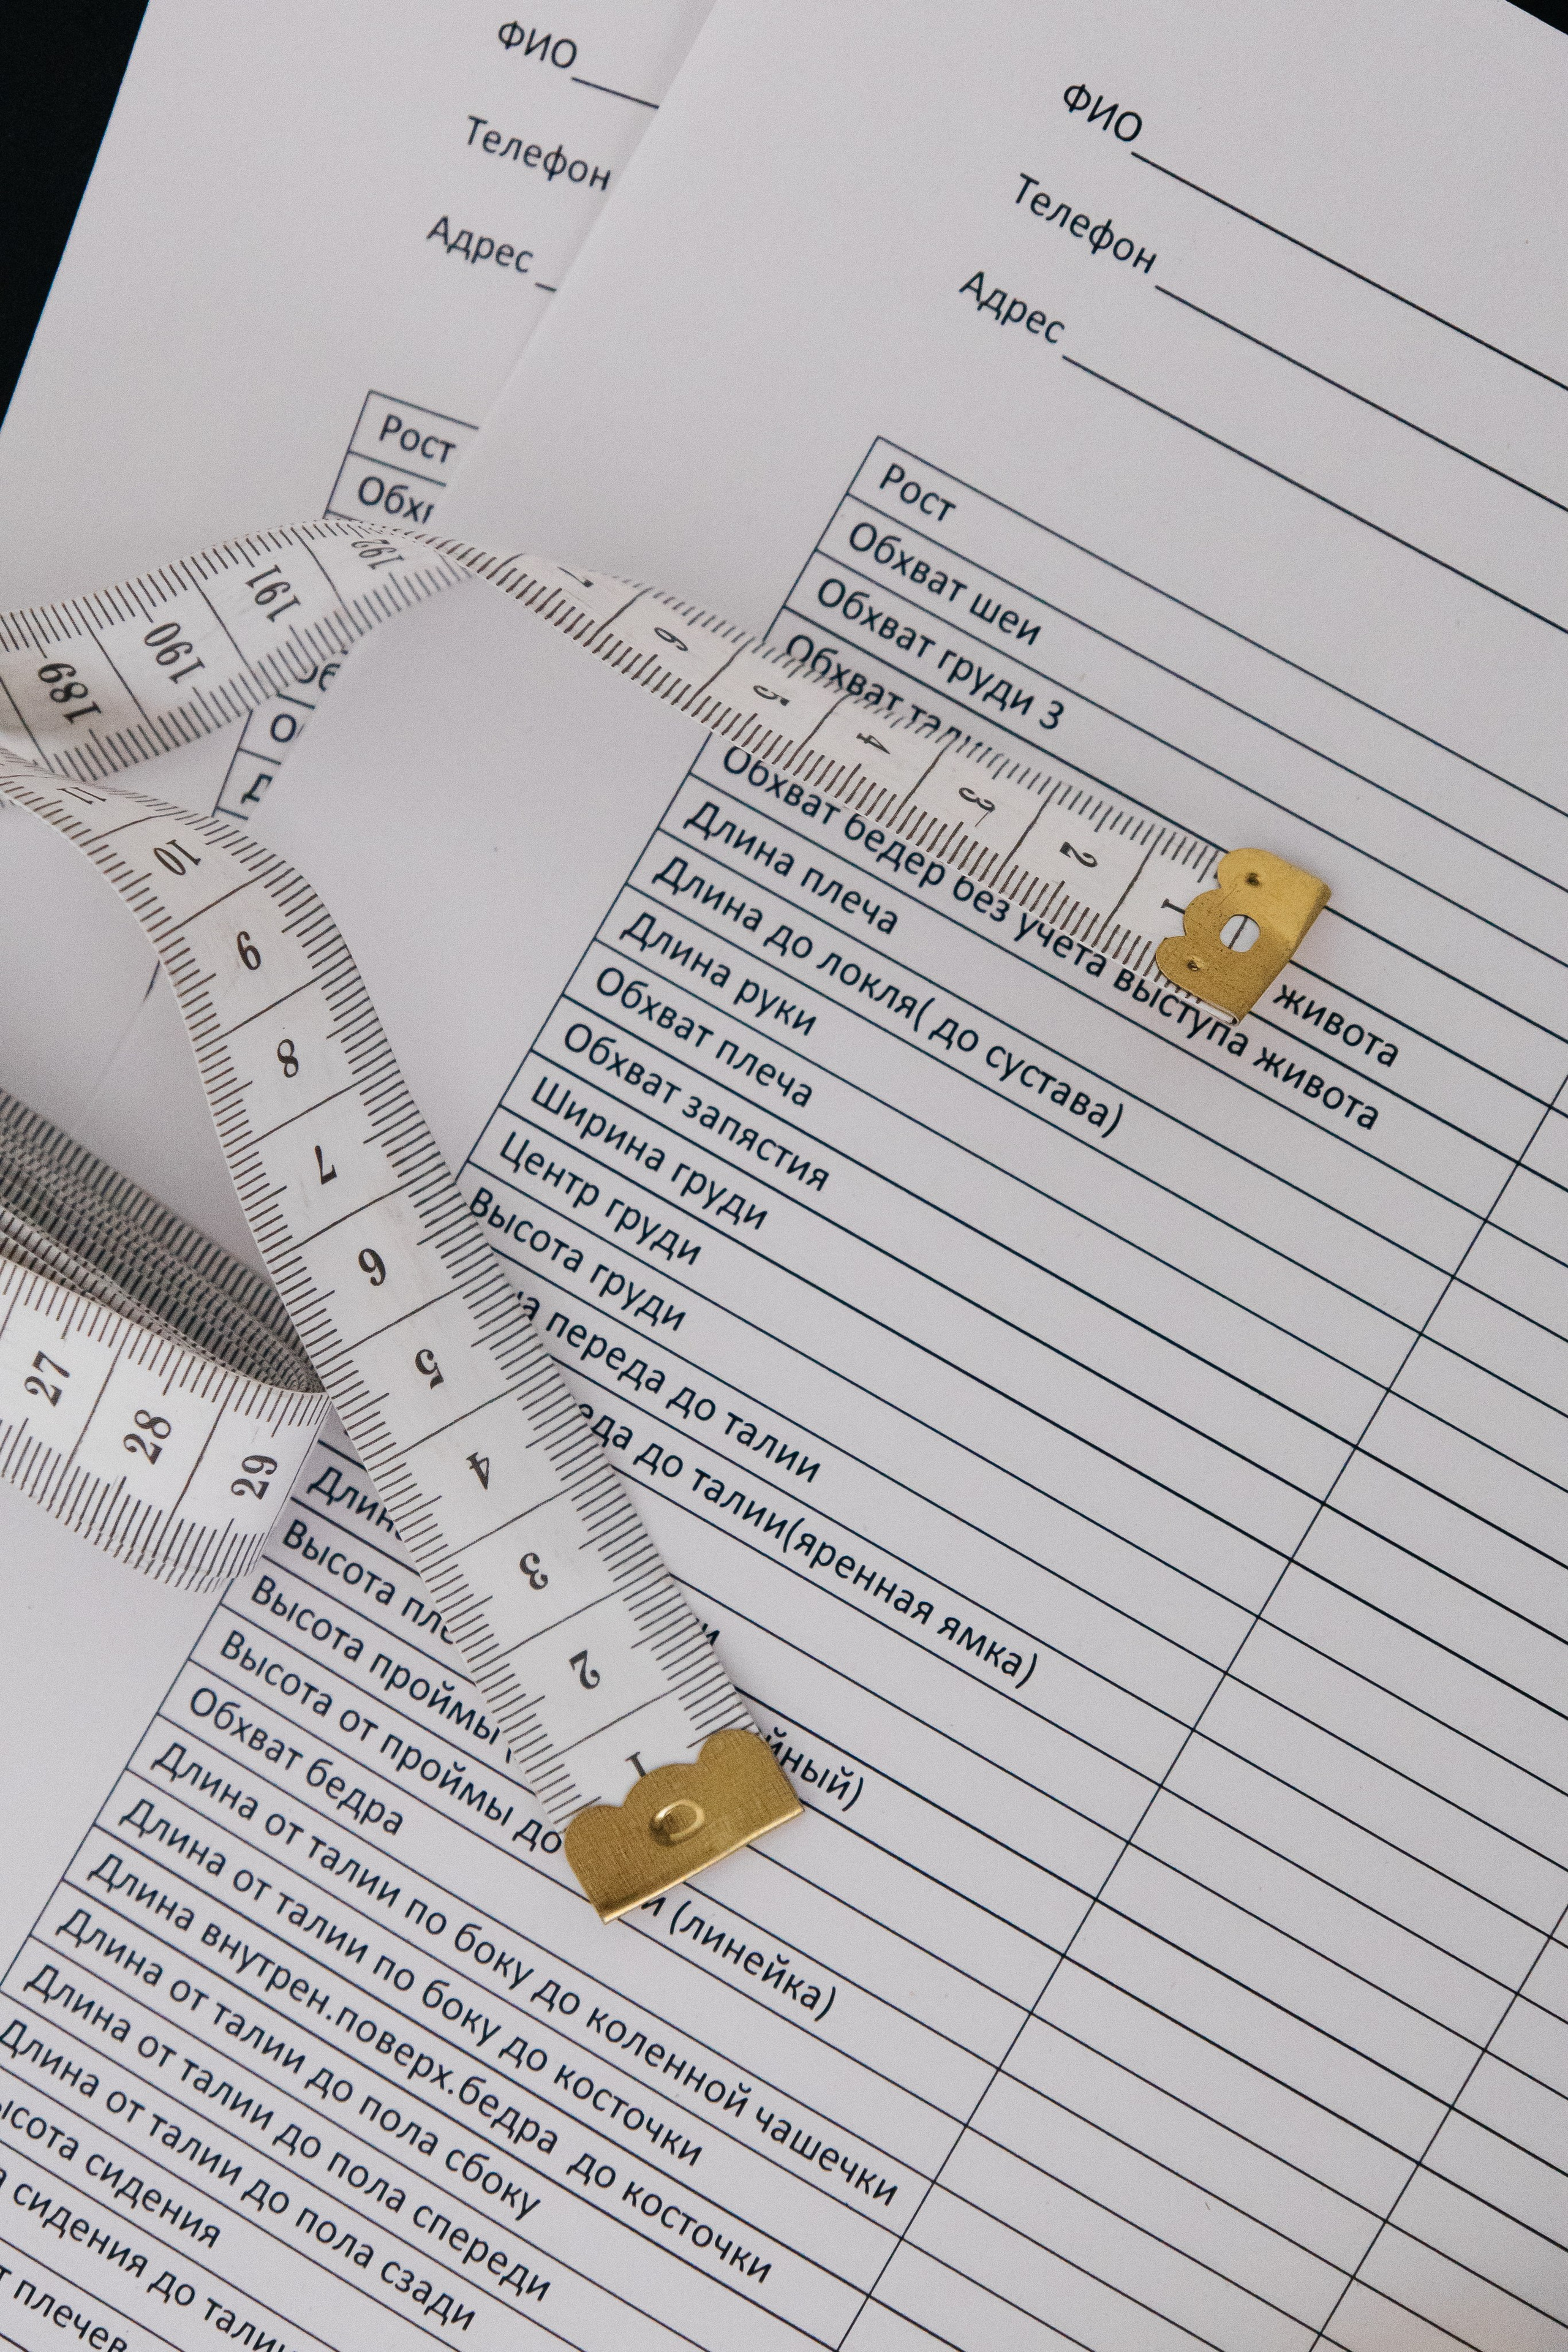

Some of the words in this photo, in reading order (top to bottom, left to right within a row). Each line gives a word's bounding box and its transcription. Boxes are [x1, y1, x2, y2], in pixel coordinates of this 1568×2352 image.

[497, 20, 578, 69] ФИО
[467, 115, 612, 192] Телефон
[1063, 83, 1143, 143] ФИО
[426, 216, 533, 274] Адрес
[1015, 172, 1158, 274] Телефон
[958, 271, 1065, 344] Адрес
[379, 413, 457, 464] Рост
[879, 462, 957, 522] Рост
[246, 564, 301, 623] 191
[848, 521, 968, 602] Обхват
[969, 593, 1042, 646] шеи
[38, 663, 102, 725] 189
[144, 622, 205, 684] 190
[817, 578, 937, 658] Обхват
[937, 649, 1035, 716] груди
[1039, 699, 1065, 730] 3
[153, 839, 202, 876] 10
[682, 801, 795, 877] Длина
[800, 867, 899, 935] плеча
[1059, 841, 1098, 869] 2
[236, 930, 262, 971] 9
[619, 911, 731, 989] Длина
[733, 978, 817, 1036] руки
[723, 745, 840, 824] Обхват
[844, 813, 946, 888] бедер
[952, 875, 1011, 922] без
[1013, 912, 1107, 978] учета
[1113, 968, 1250, 1057] выступа
[1252, 1046, 1379, 1131] живота
[596, 967, 715, 1048] Обхват
[715, 1039, 813, 1108] плеча
[650, 856, 763, 933] Длина
[762, 924, 813, 959] до
[927, 1017, 979, 1053] до
[985, 1045, 1124, 1139] сустава)
[1273, 984, 1399, 1068] живота
[276, 1038, 300, 1079] 8
[564, 1022, 682, 1104] Обхват
[681, 1095, 830, 1192] запястия
[314, 1145, 337, 1185] 7
[530, 1076, 666, 1172] Ширина
[670, 1162, 768, 1231] груди
[499, 1131, 600, 1209] Центр
[605, 1197, 702, 1266] груди
[358, 1248, 387, 1287] 6
[469, 1186, 584, 1273] Высота
[589, 1263, 687, 1332] груди
[24, 1350, 70, 1407] 27
[415, 1348, 445, 1390] 5
[545, 1311, 666, 1395] переда
[665, 1386, 717, 1422] до
[724, 1411, 821, 1483] талии
[123, 1409, 172, 1465] 28
[230, 1454, 278, 1500] 29
[466, 1452, 490, 1490] 4
[306, 1466, 403, 1542] Длин
[282, 1518, 396, 1606] Высота
[519, 1551, 549, 1591] 3
[632, 1442, 684, 1479] до
[937, 1616, 1038, 1690] ямка)
[251, 1574, 364, 1662] Высота
[369, 1653, 500, 1746] проймы
[568, 1649, 601, 1690] 2
[189, 1687, 304, 1771] Обхват
[306, 1757, 404, 1836] бедра
[220, 1629, 333, 1717] Высота
[339, 1709, 379, 1741] от
[379, 1733, 514, 1826] проймы
[511, 1819, 562, 1854] до
[669, 1900, 837, 2022] (линейка)
[118, 1798, 227, 1877] Длина
[232, 1869, 273, 1901] от
[276, 1891, 369, 1964] талии
[372, 1954, 415, 1992] по
[421, 1979, 502, 2048] боку
[497, 2036, 548, 2072] до
[553, 2064, 703, 2167] косточки
[149, 1741, 259, 1821] Длина
[265, 1813, 305, 1845] от
[308, 1835, 401, 1908] талии
[404, 1898, 448, 1936] по
[454, 1922, 535, 1991] боку
[529, 1979, 581, 2016] до
[586, 2007, 752, 2118] коленной
[755, 2106, 899, 2207] чашечки
[55, 1908, 164, 1987] Длина
[169, 1979, 209, 2011] от
[213, 2002, 306, 2075] талии
[303, 2067, 354, 2103] до
[358, 2095, 439, 2157] пола
[445, 2149, 541, 2222] сбоку
[86, 1853, 195, 1932] Длина
[565, 2152, 617, 2189] до
[621, 2180, 772, 2284] косточки
[0, 2019, 100, 2098] Длина
[105, 2090, 146, 2123] от
[149, 2113, 243, 2187] талии
[239, 2178, 290, 2215] до
[295, 2207, 375, 2269] пола
[380, 2261, 476, 2332] сзади
[22, 1964, 132, 2043] Длина
[137, 2035, 178, 2068] от
[181, 2057, 274, 2131] талии
[271, 2123, 322, 2159] до
[326, 2151, 407, 2214] пола
[412, 2205, 551, 2302] спереди
[85, 2153, 221, 2249] сидения
[12, 2183, 149, 2278] сидения
[146, 2271, 196, 2307] до
[204, 2297, 295, 2352] тали
